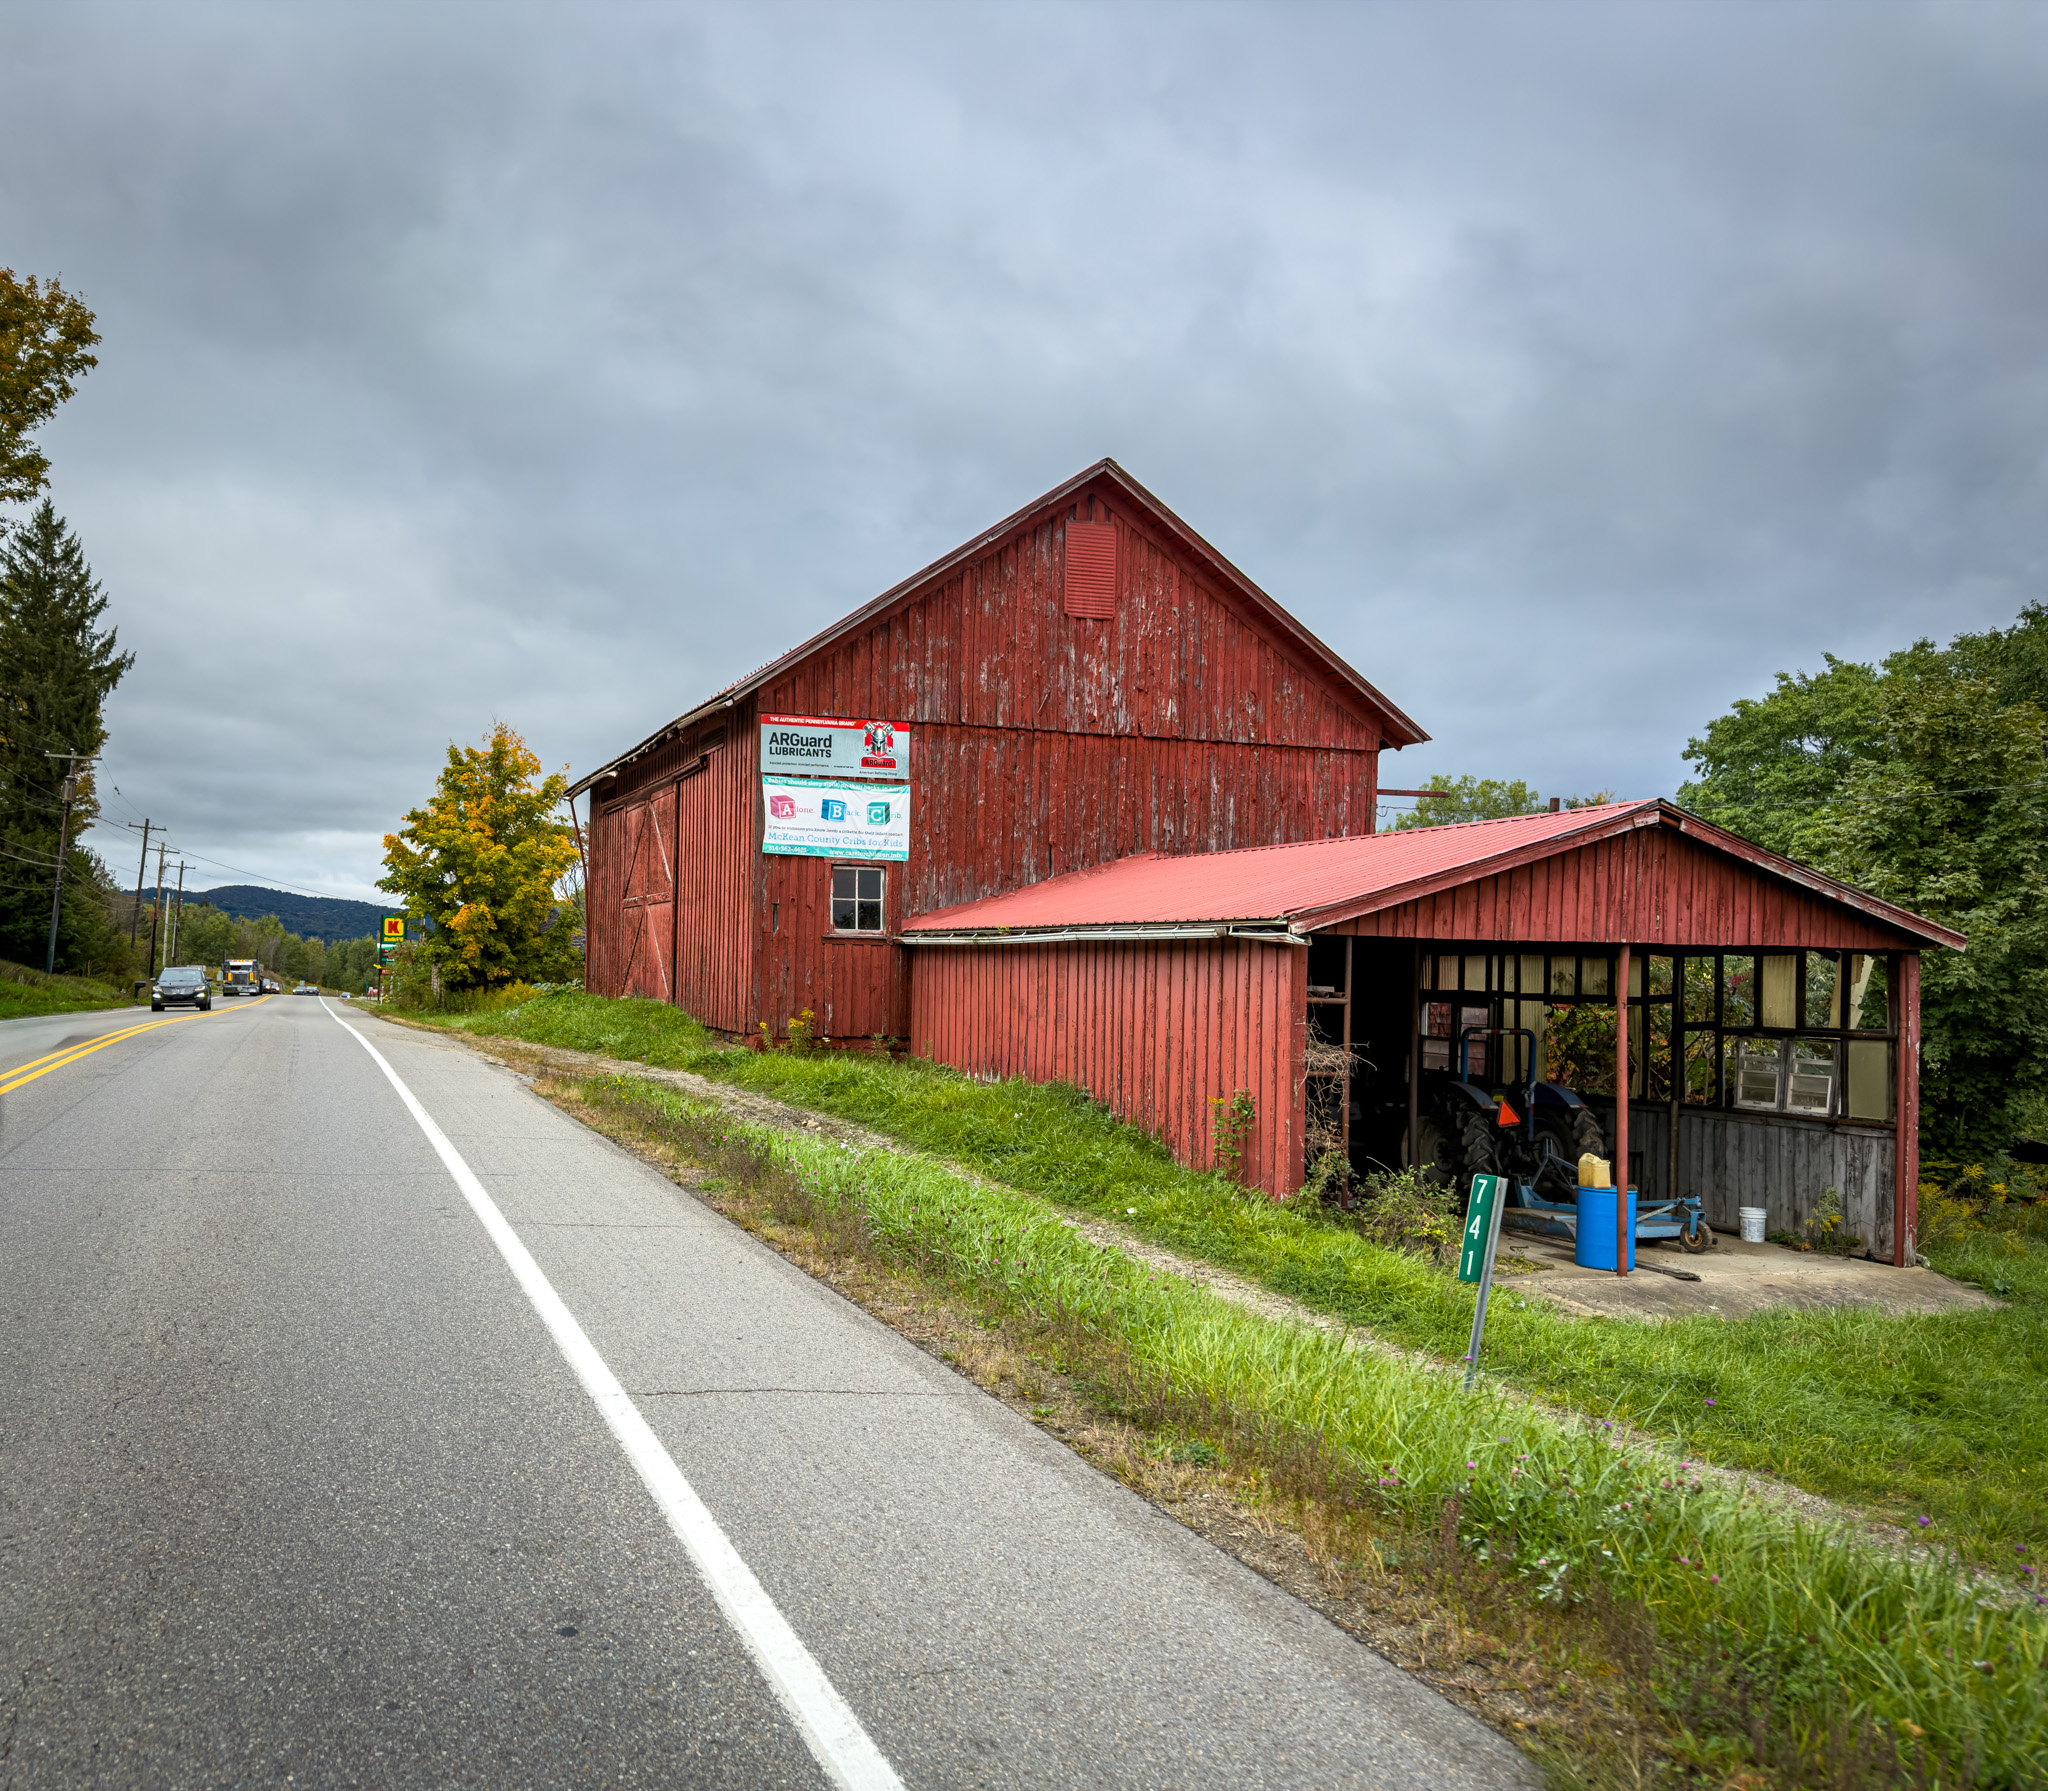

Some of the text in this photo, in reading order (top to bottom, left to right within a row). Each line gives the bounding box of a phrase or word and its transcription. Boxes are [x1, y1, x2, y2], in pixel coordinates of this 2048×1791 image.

[805, 718, 838, 726] PENNSYLVANIA
[769, 732, 832, 748] ARGuard
[769, 746, 831, 758] LUBRICANTS
[864, 759, 893, 767] ARGuard
[768, 832, 903, 847] McKean County Cribs for Kids
[388, 921, 400, 933] K
